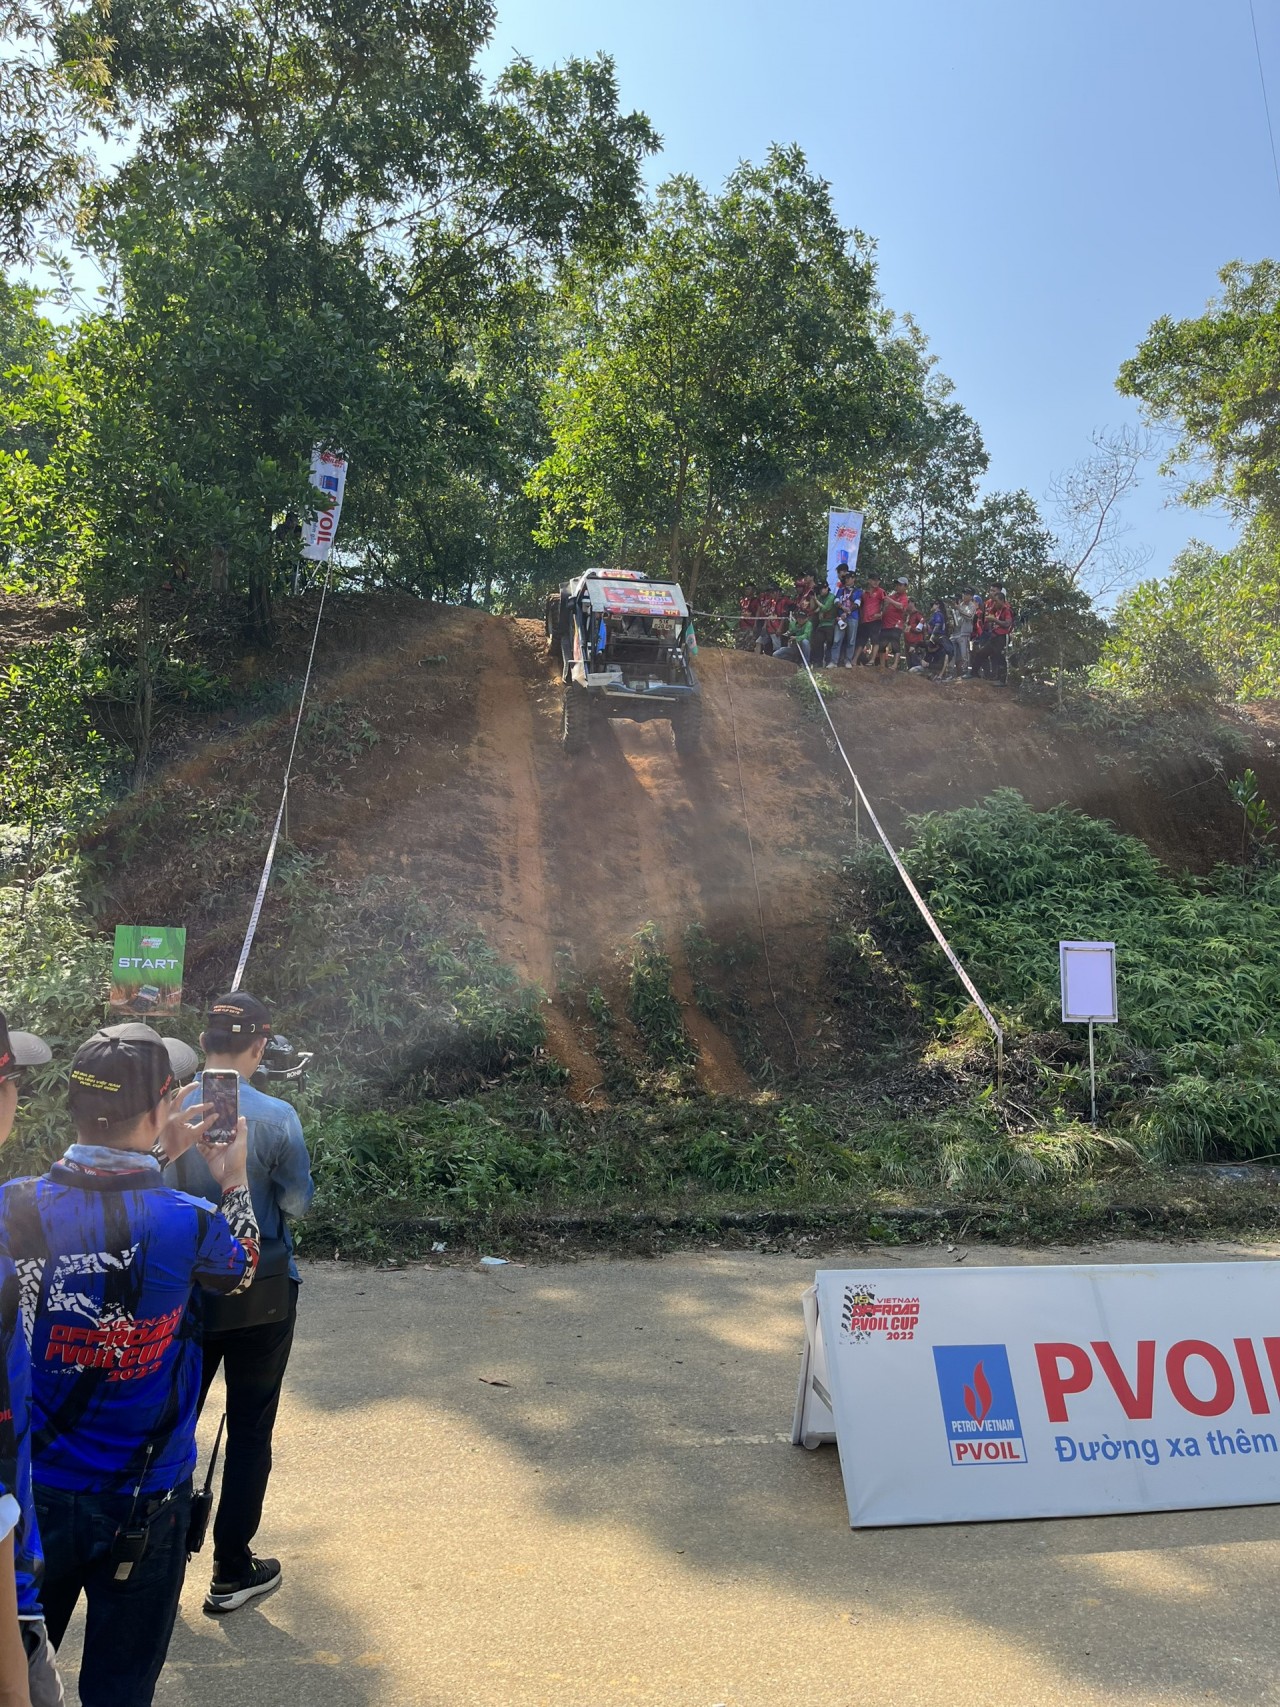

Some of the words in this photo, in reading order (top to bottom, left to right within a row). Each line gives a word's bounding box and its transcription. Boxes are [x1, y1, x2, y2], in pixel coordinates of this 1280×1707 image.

[118, 957, 179, 969] START
[852, 1304, 920, 1317] OFFROAD
[850, 1317, 889, 1331] PVOIL
[890, 1316, 919, 1330] CUP
[50, 1315, 180, 1348] OFFROAD
[886, 1331, 914, 1341] 2022
[45, 1342, 115, 1369] PVOIL
[118, 1335, 173, 1368] CUP
[951, 1419, 1015, 1433] PETROVIETNAM
[955, 1442, 1020, 1461] PVOIL
[1055, 1434, 1160, 1466] Đường
[1166, 1435, 1201, 1458] xa
[1206, 1428, 1279, 1456] thêm
